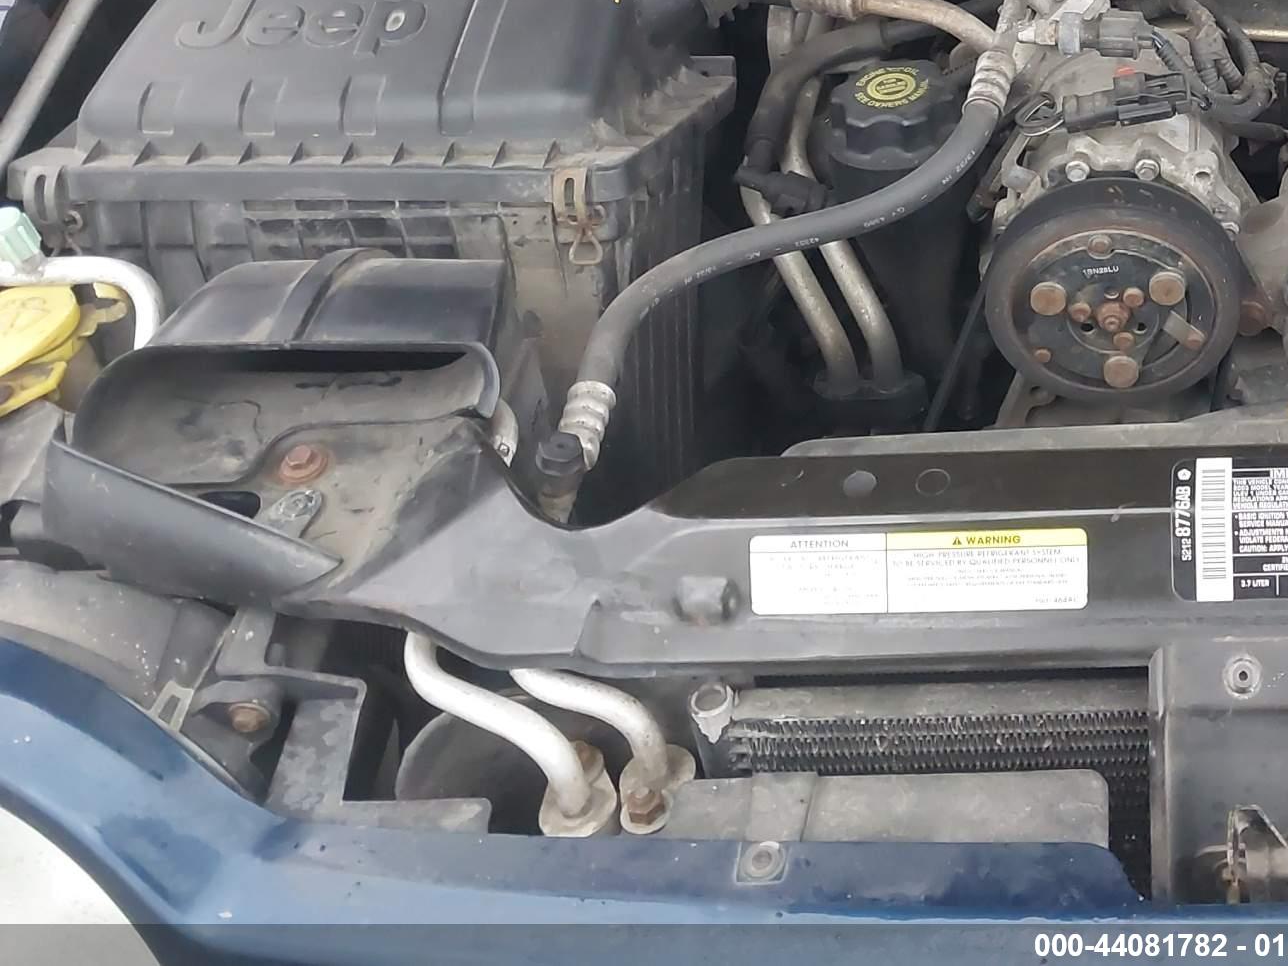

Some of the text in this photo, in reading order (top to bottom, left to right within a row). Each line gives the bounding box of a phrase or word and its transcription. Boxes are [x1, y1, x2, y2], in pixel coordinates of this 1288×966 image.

[790, 539, 849, 549] ATTENTION
[966, 535, 1021, 545] WARNING
[1240, 579, 1270, 588] 3.7 LITER
